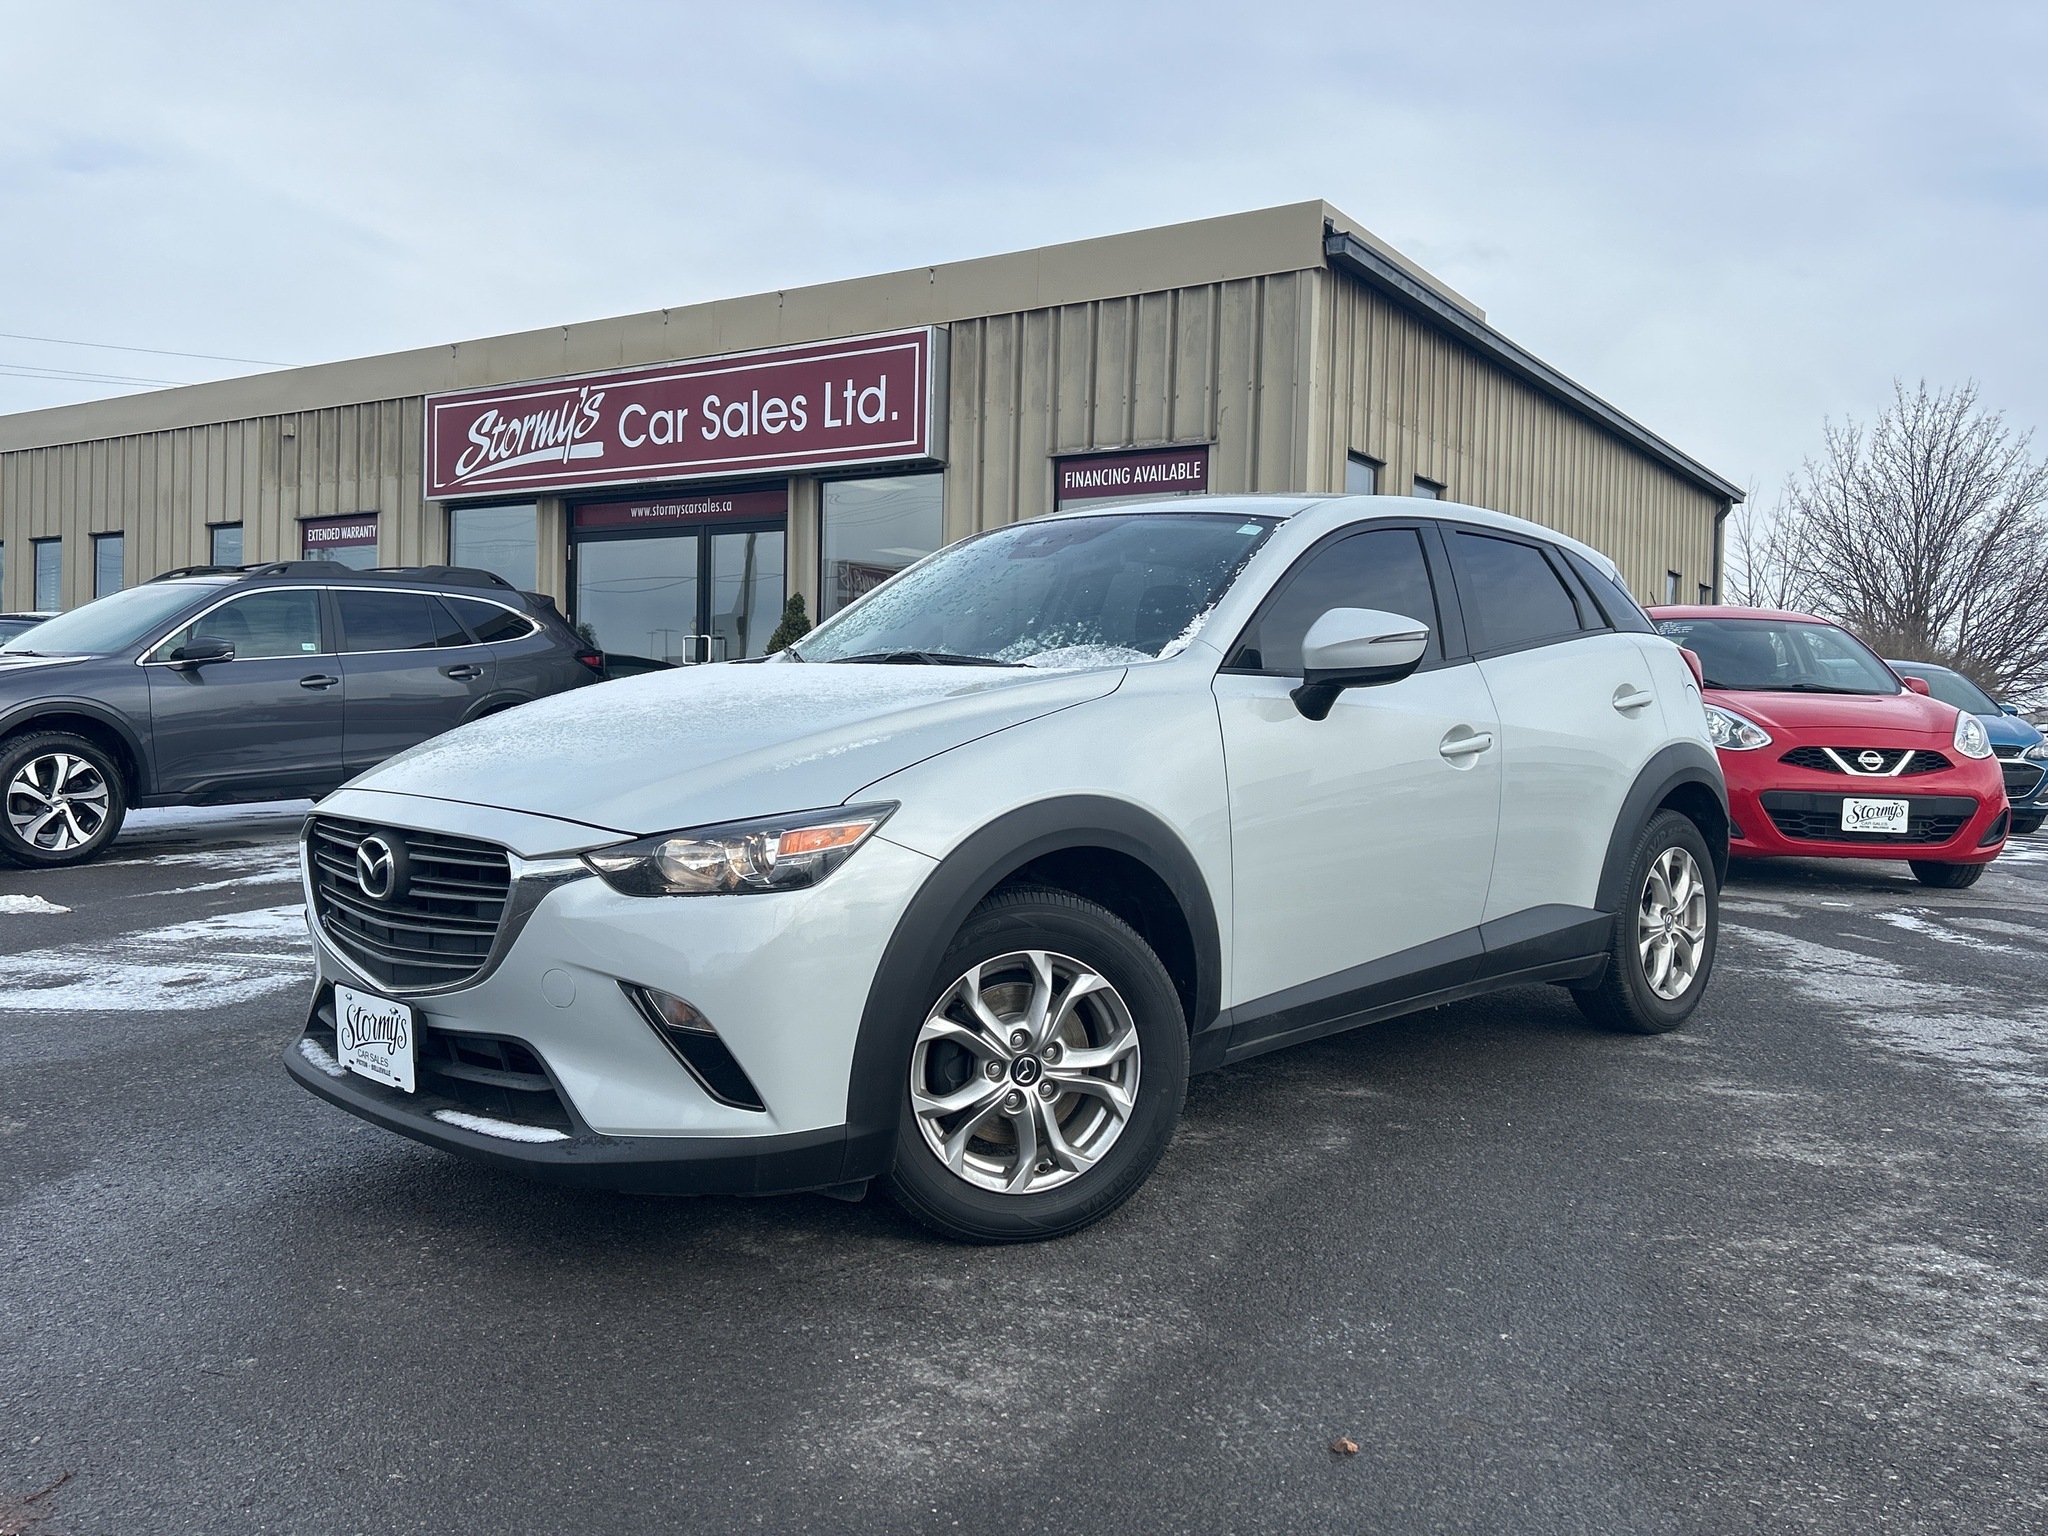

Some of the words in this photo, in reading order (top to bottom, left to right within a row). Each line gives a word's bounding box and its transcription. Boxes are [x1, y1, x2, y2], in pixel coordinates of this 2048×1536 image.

[455, 385, 605, 477] Stormy's
[617, 404, 689, 449] Car
[702, 390, 808, 438] Sales
[824, 374, 899, 428] Ltd.
[1064, 467, 1131, 489] FINANCING
[1133, 461, 1201, 484] AVAILABLE
[630, 498, 732, 518] www.stormyscarsales.ca
[307, 527, 340, 542] EXTENDED
[341, 524, 377, 540] WARRANTY
[1846, 804, 1904, 824] Stormy's
[341, 1003, 407, 1056] Stormy's
[357, 1048, 369, 1061] CAR
[370, 1053, 389, 1068] SALES
